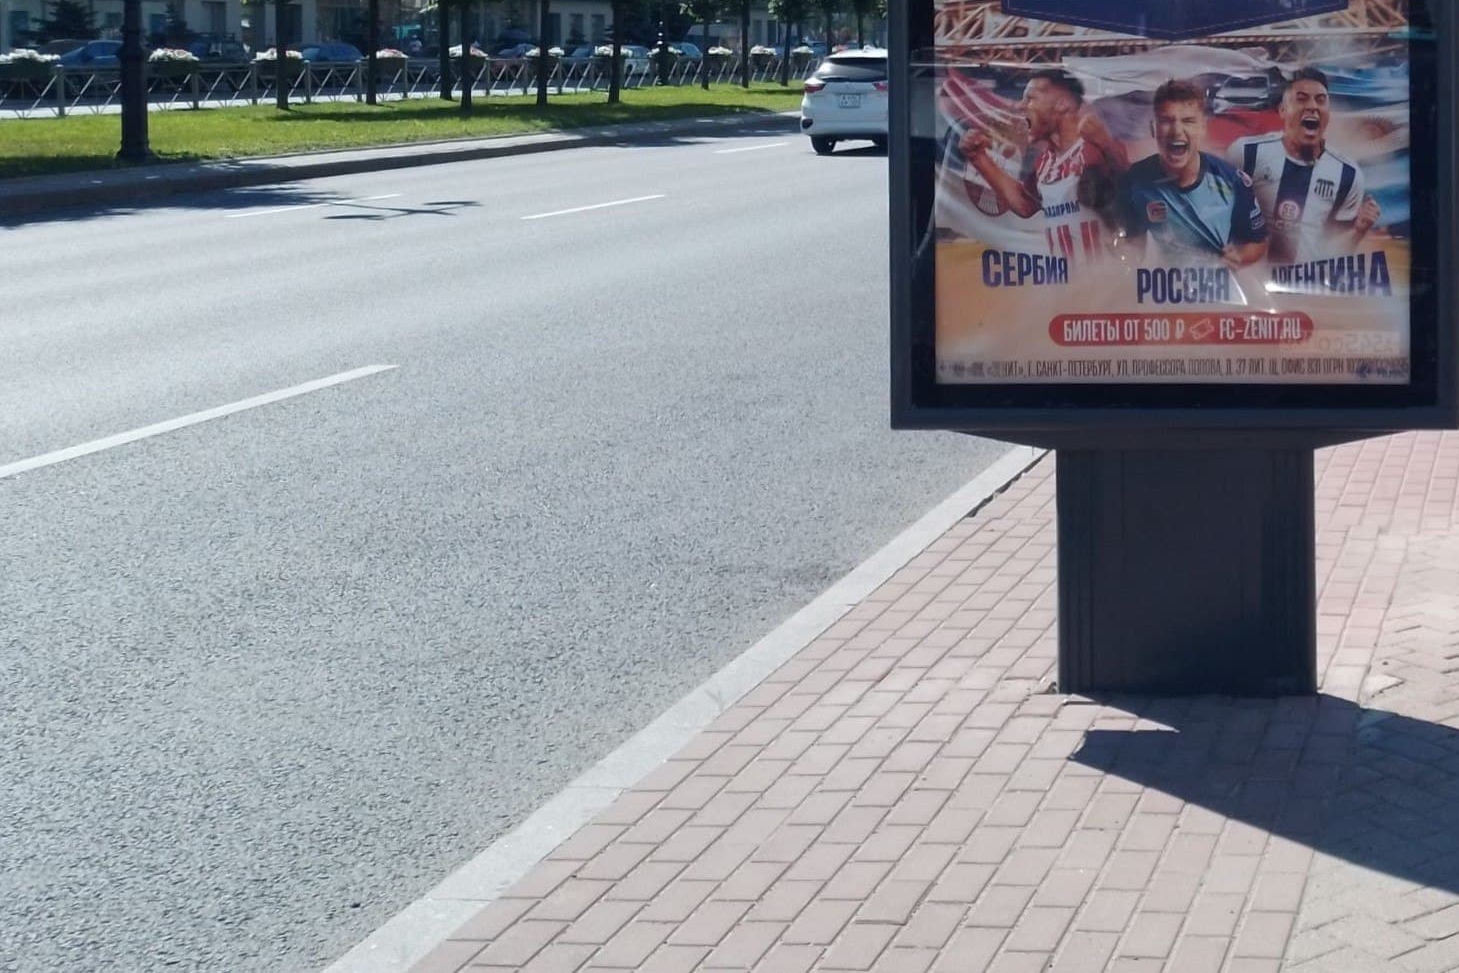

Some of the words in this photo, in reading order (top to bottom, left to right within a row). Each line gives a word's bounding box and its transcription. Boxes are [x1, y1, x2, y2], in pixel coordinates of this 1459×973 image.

[981, 248, 1069, 288] СЕРБИЯ
[1136, 266, 1231, 305] РОССИЯ
[1063, 319, 1120, 342] БИЛЕТЫ
[1124, 319, 1140, 341] ОТ
[1144, 318, 1171, 340] 500
[1219, 317, 1301, 341] FC-ZENIT.RU
